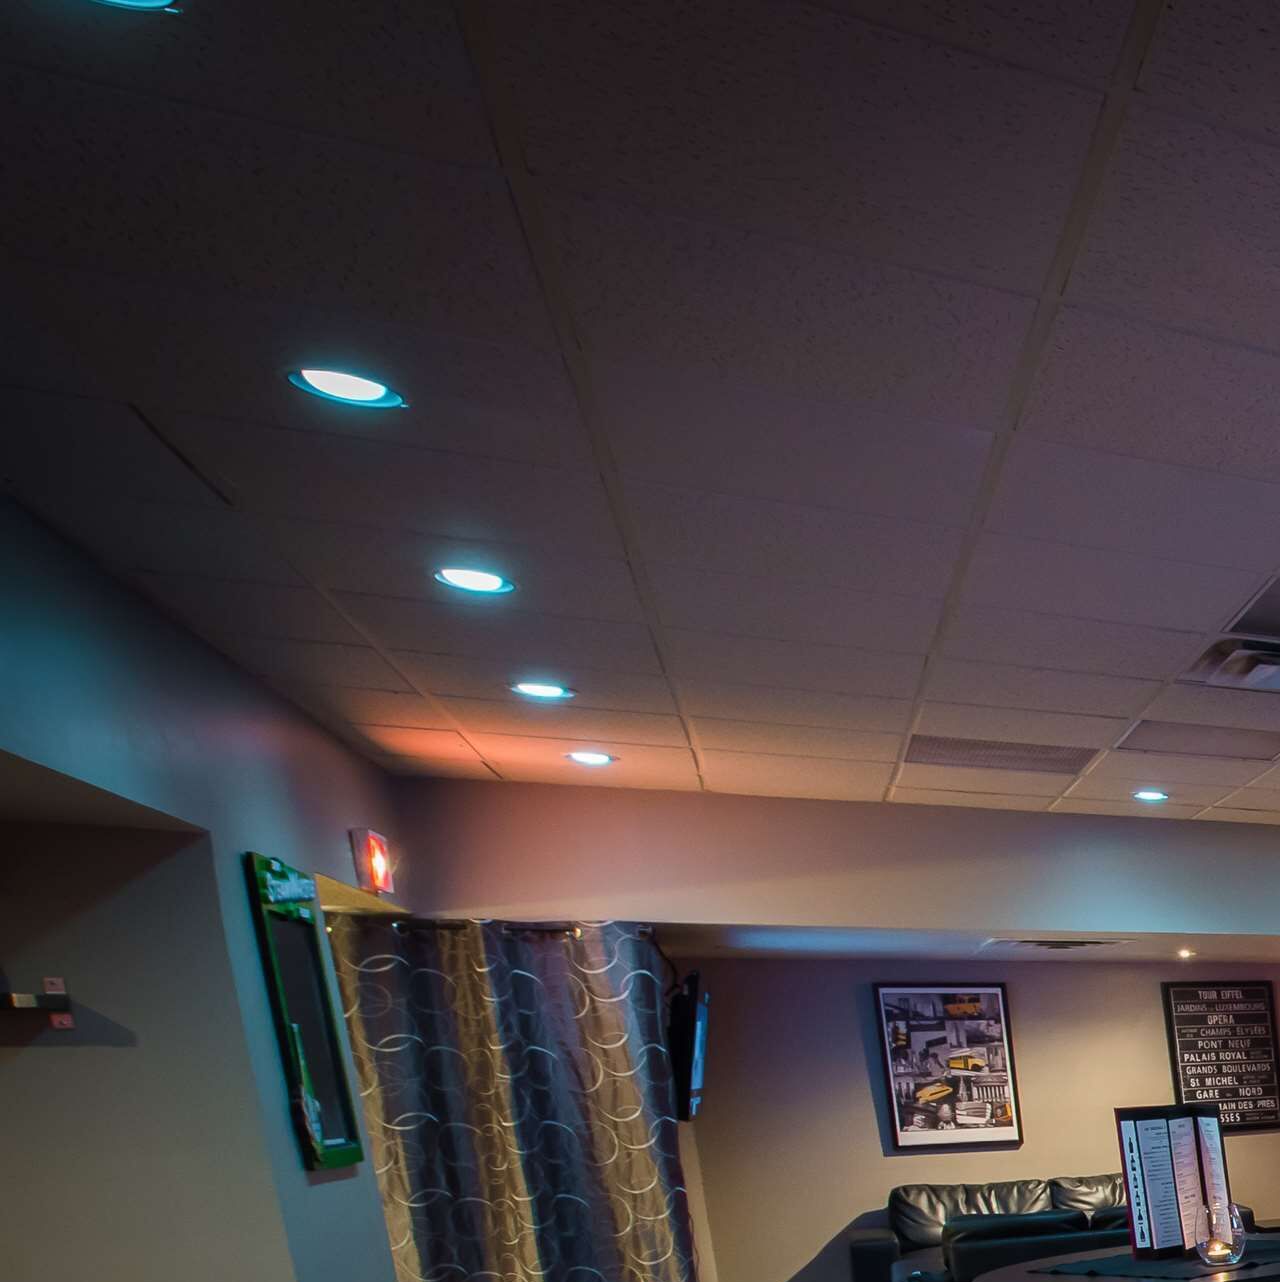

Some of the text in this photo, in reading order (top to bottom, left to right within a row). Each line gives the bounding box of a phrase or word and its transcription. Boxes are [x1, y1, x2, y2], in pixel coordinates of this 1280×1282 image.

[1198, 990, 1217, 1001] TOUR
[1198, 1040, 1251, 1050] PONT NEUF
[1184, 1052, 1216, 1063] PALAIS
[1220, 1051, 1248, 1061] ROYAL
[1186, 1063, 1271, 1076] GRANDS BOULEVARDS
[1206, 1076, 1239, 1087] MICHEL
[1196, 1090, 1220, 1100] GARE
[1239, 1087, 1263, 1097] NORD
[1238, 1101, 1253, 1110] DES
